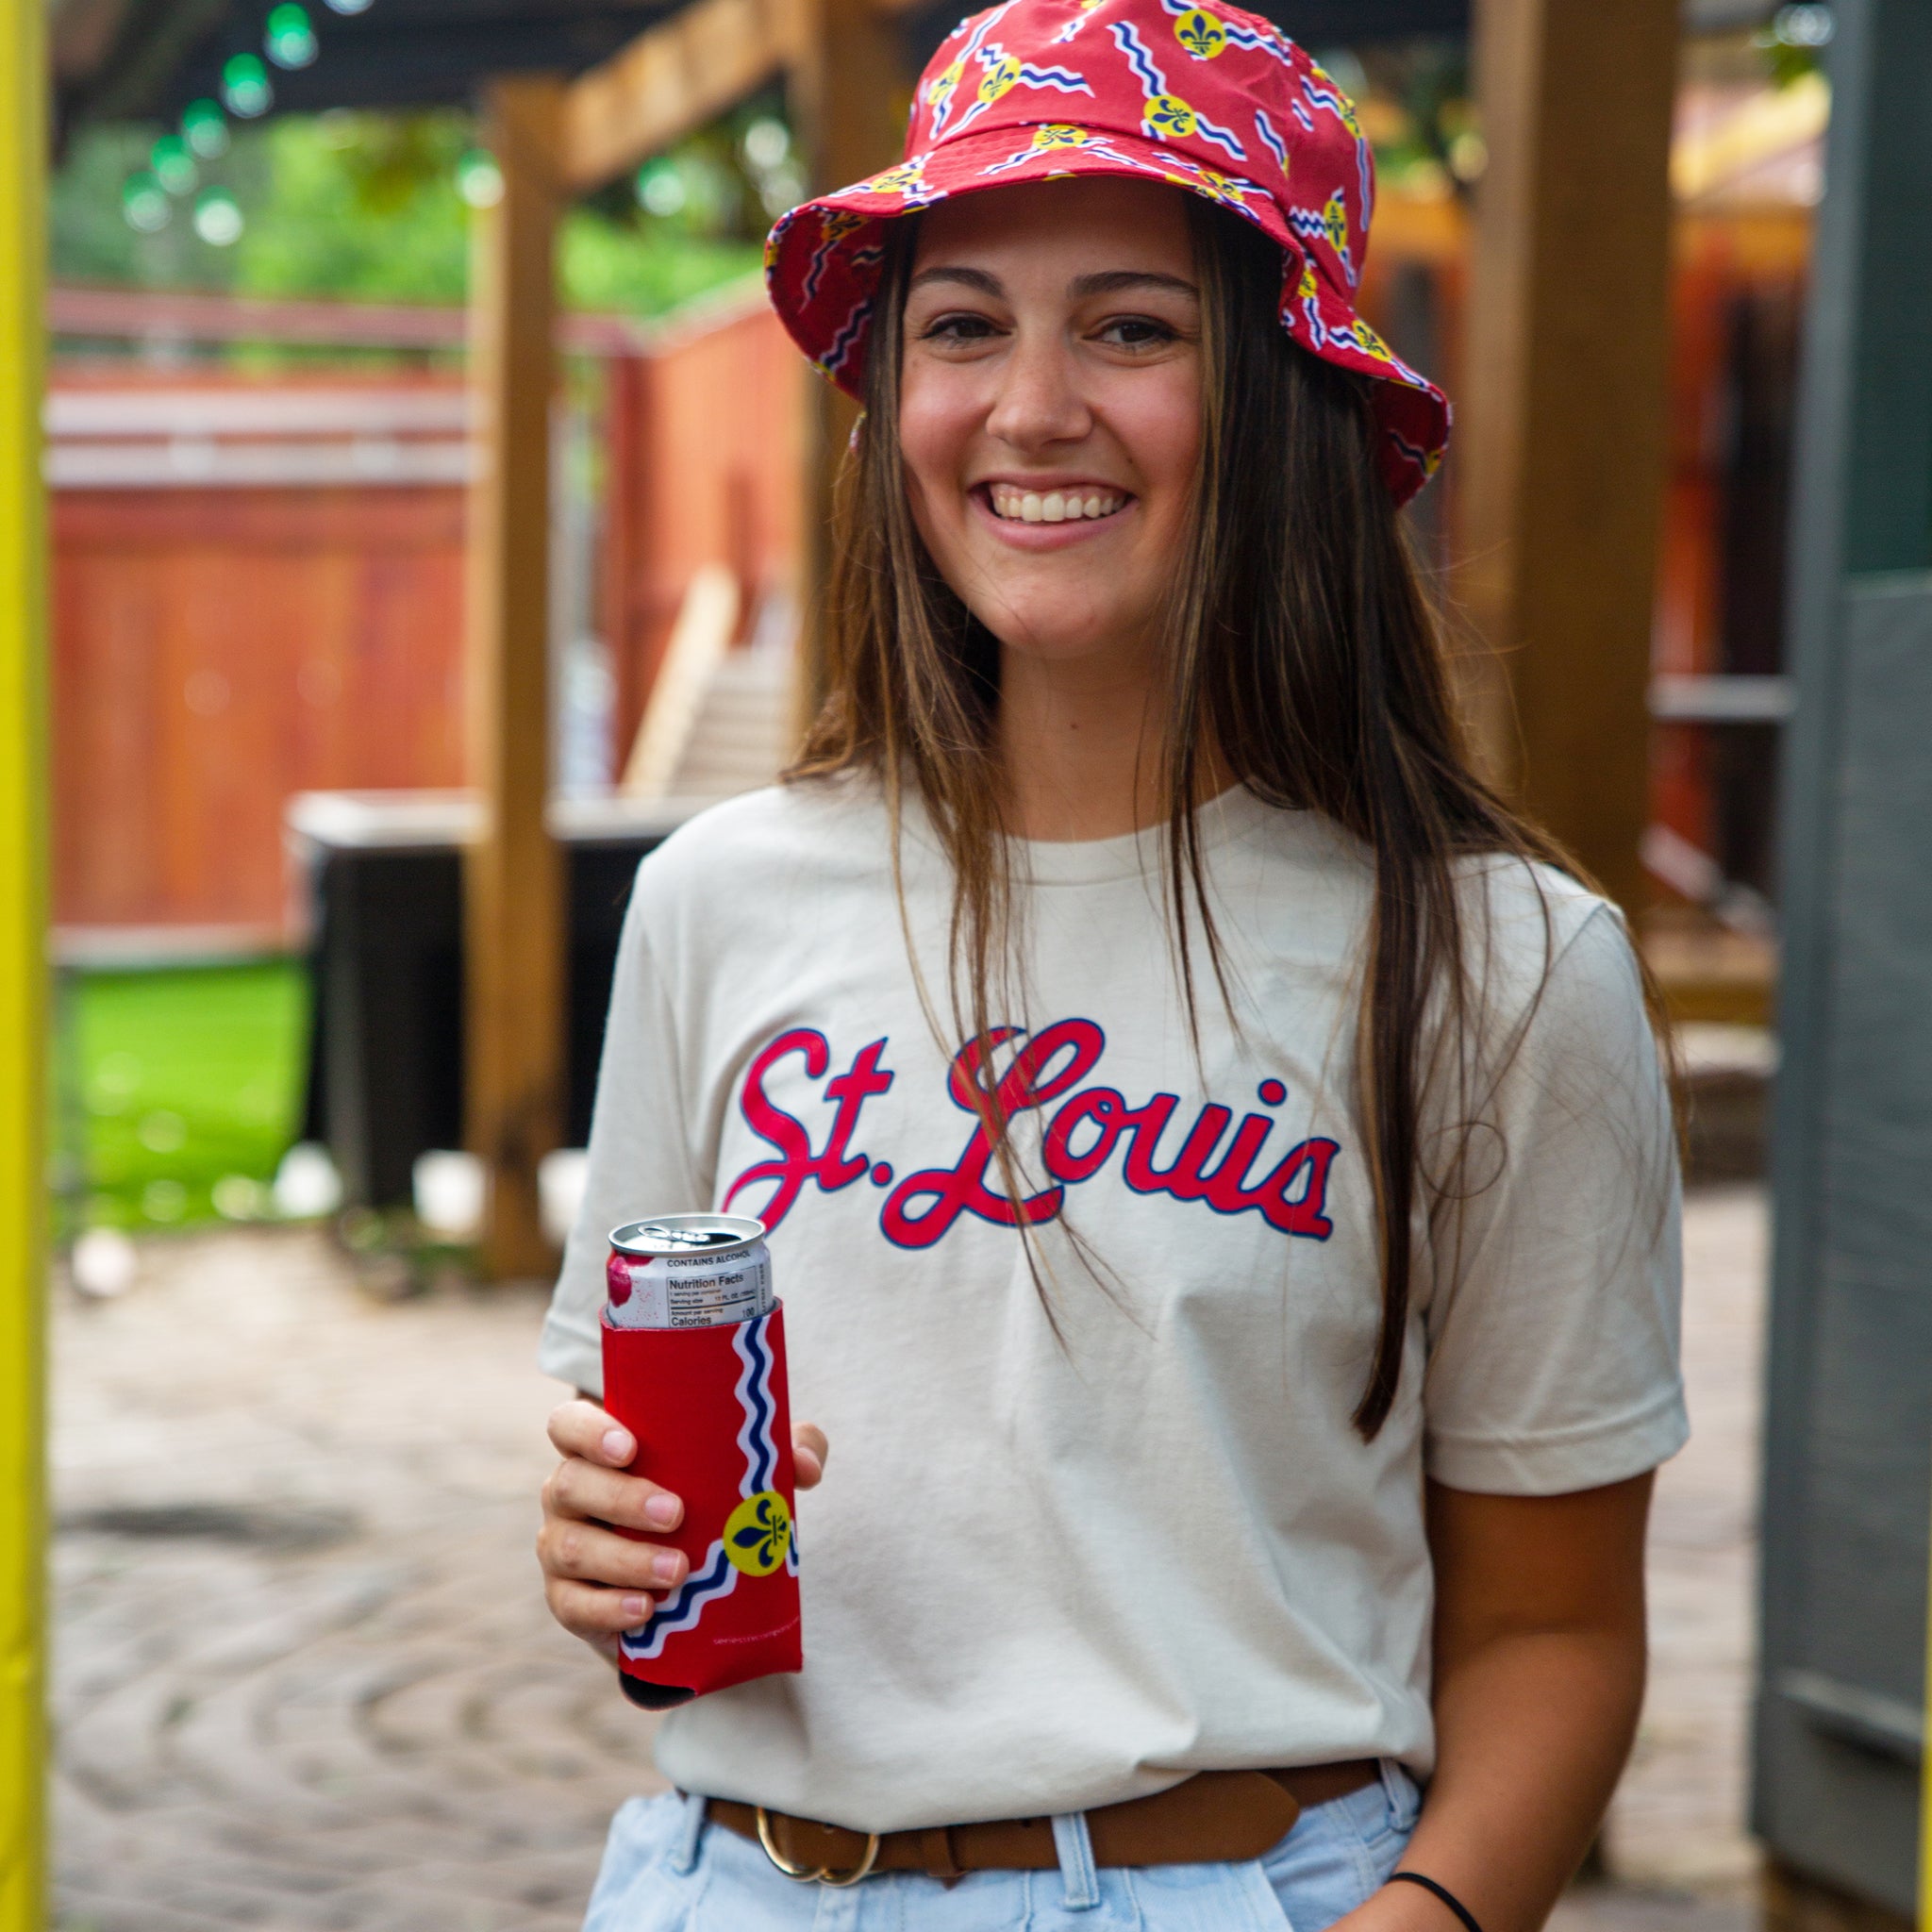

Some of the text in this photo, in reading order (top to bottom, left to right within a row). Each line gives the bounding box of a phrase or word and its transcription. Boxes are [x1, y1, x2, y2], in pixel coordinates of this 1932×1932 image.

[721, 1018, 1341, 1250] St. Louis
[667, 1251, 751, 1267] CONTAINS ALCOHOL
[669, 1274, 744, 1290] Nutrition Facts
[671, 1316, 712, 1326] Calories
